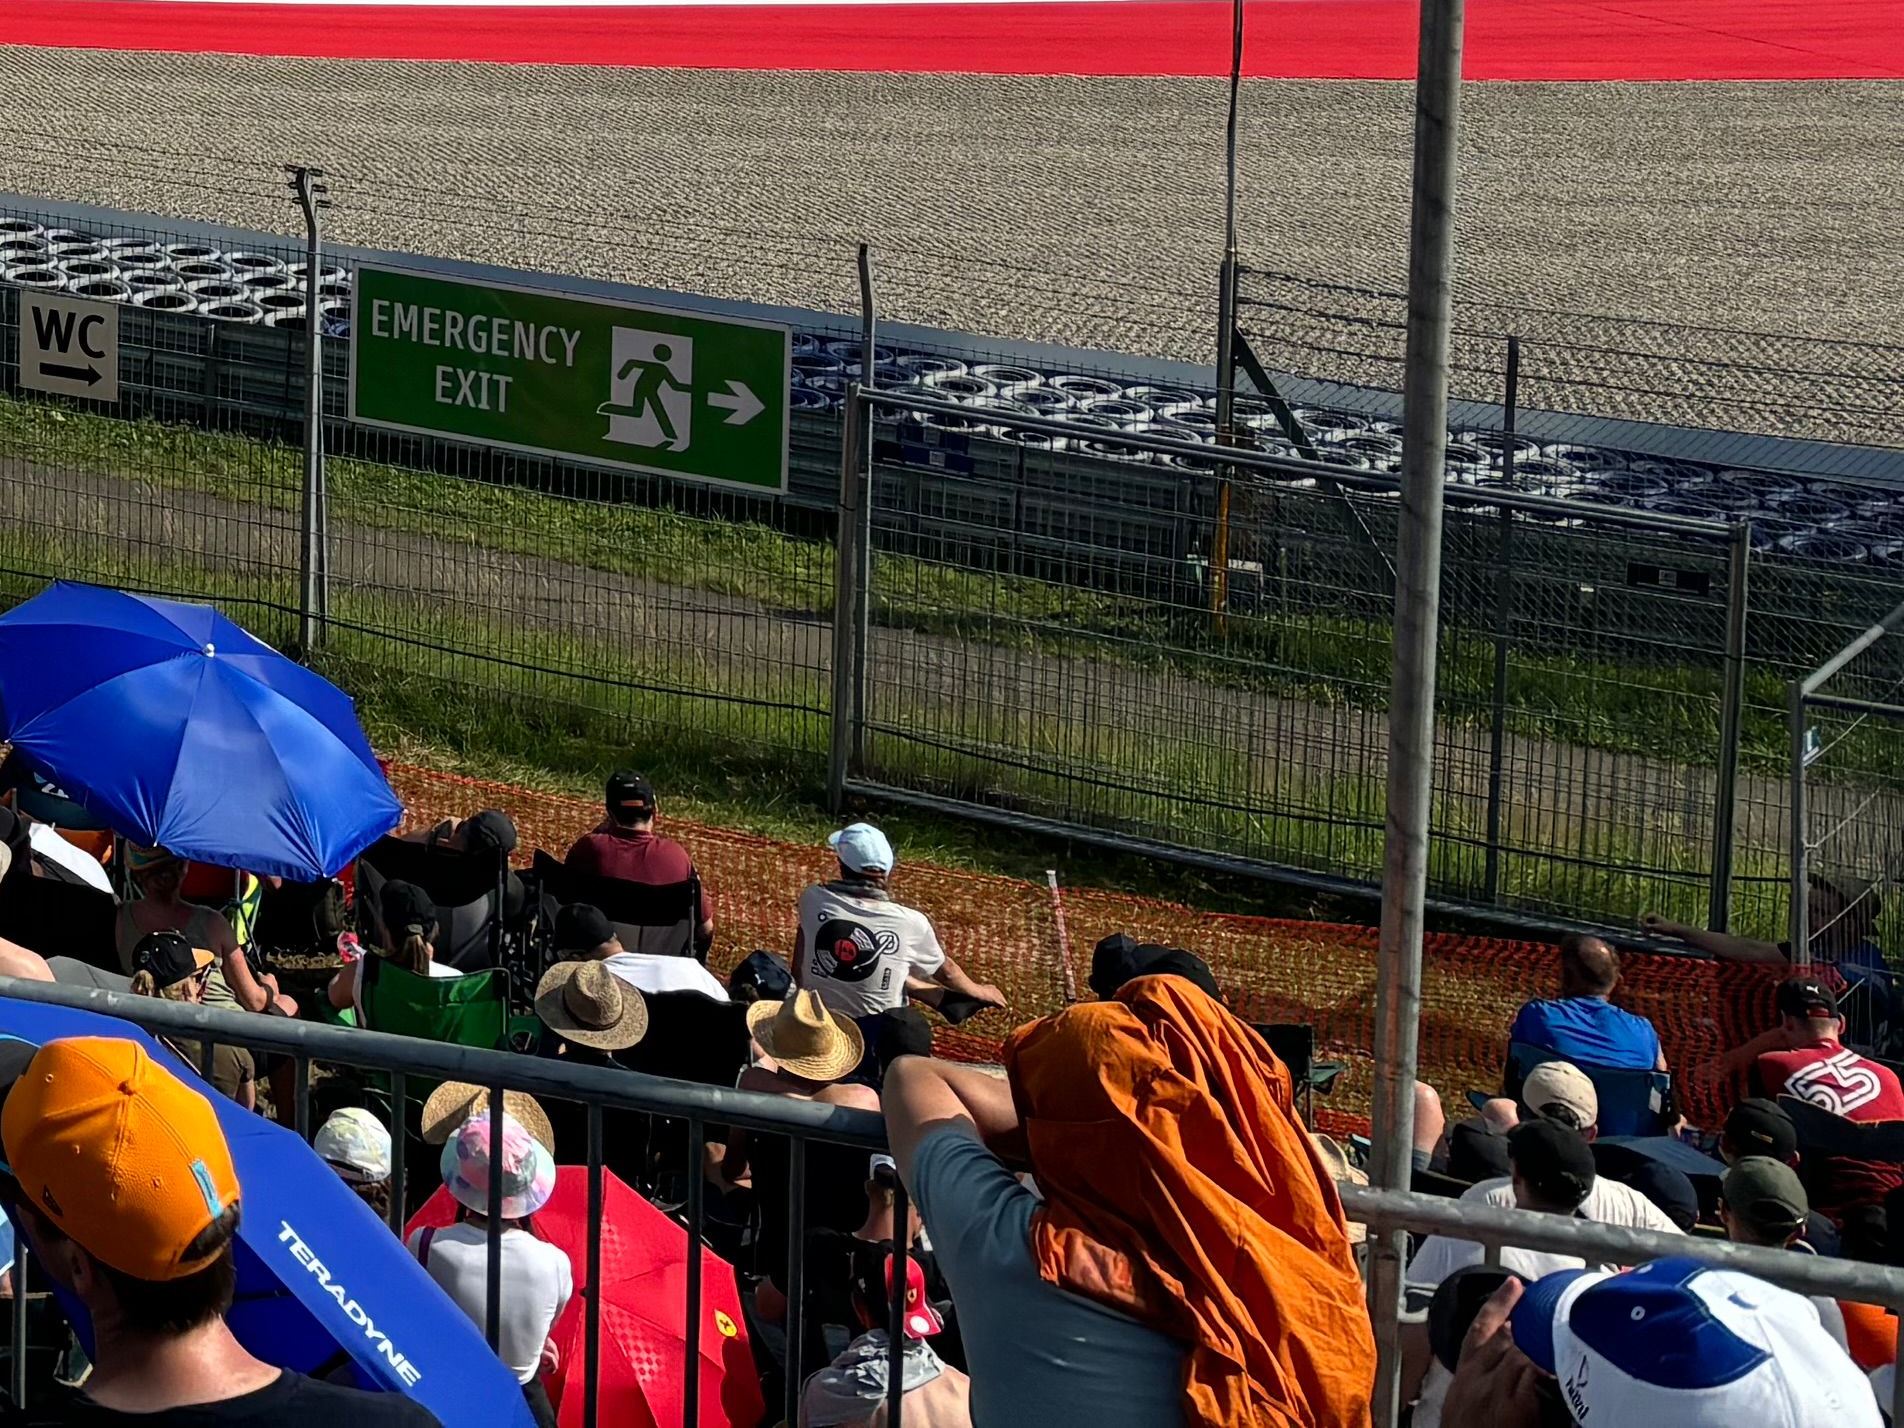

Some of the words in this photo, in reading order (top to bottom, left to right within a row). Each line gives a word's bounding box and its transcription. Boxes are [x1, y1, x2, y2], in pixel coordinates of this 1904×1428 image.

[32, 306, 106, 359] WC
[372, 298, 581, 367] EMERGENCY
[435, 364, 513, 413] EXIT
[1784, 1049, 1882, 1117] 55
[278, 1220, 422, 1387] TERADYNE
